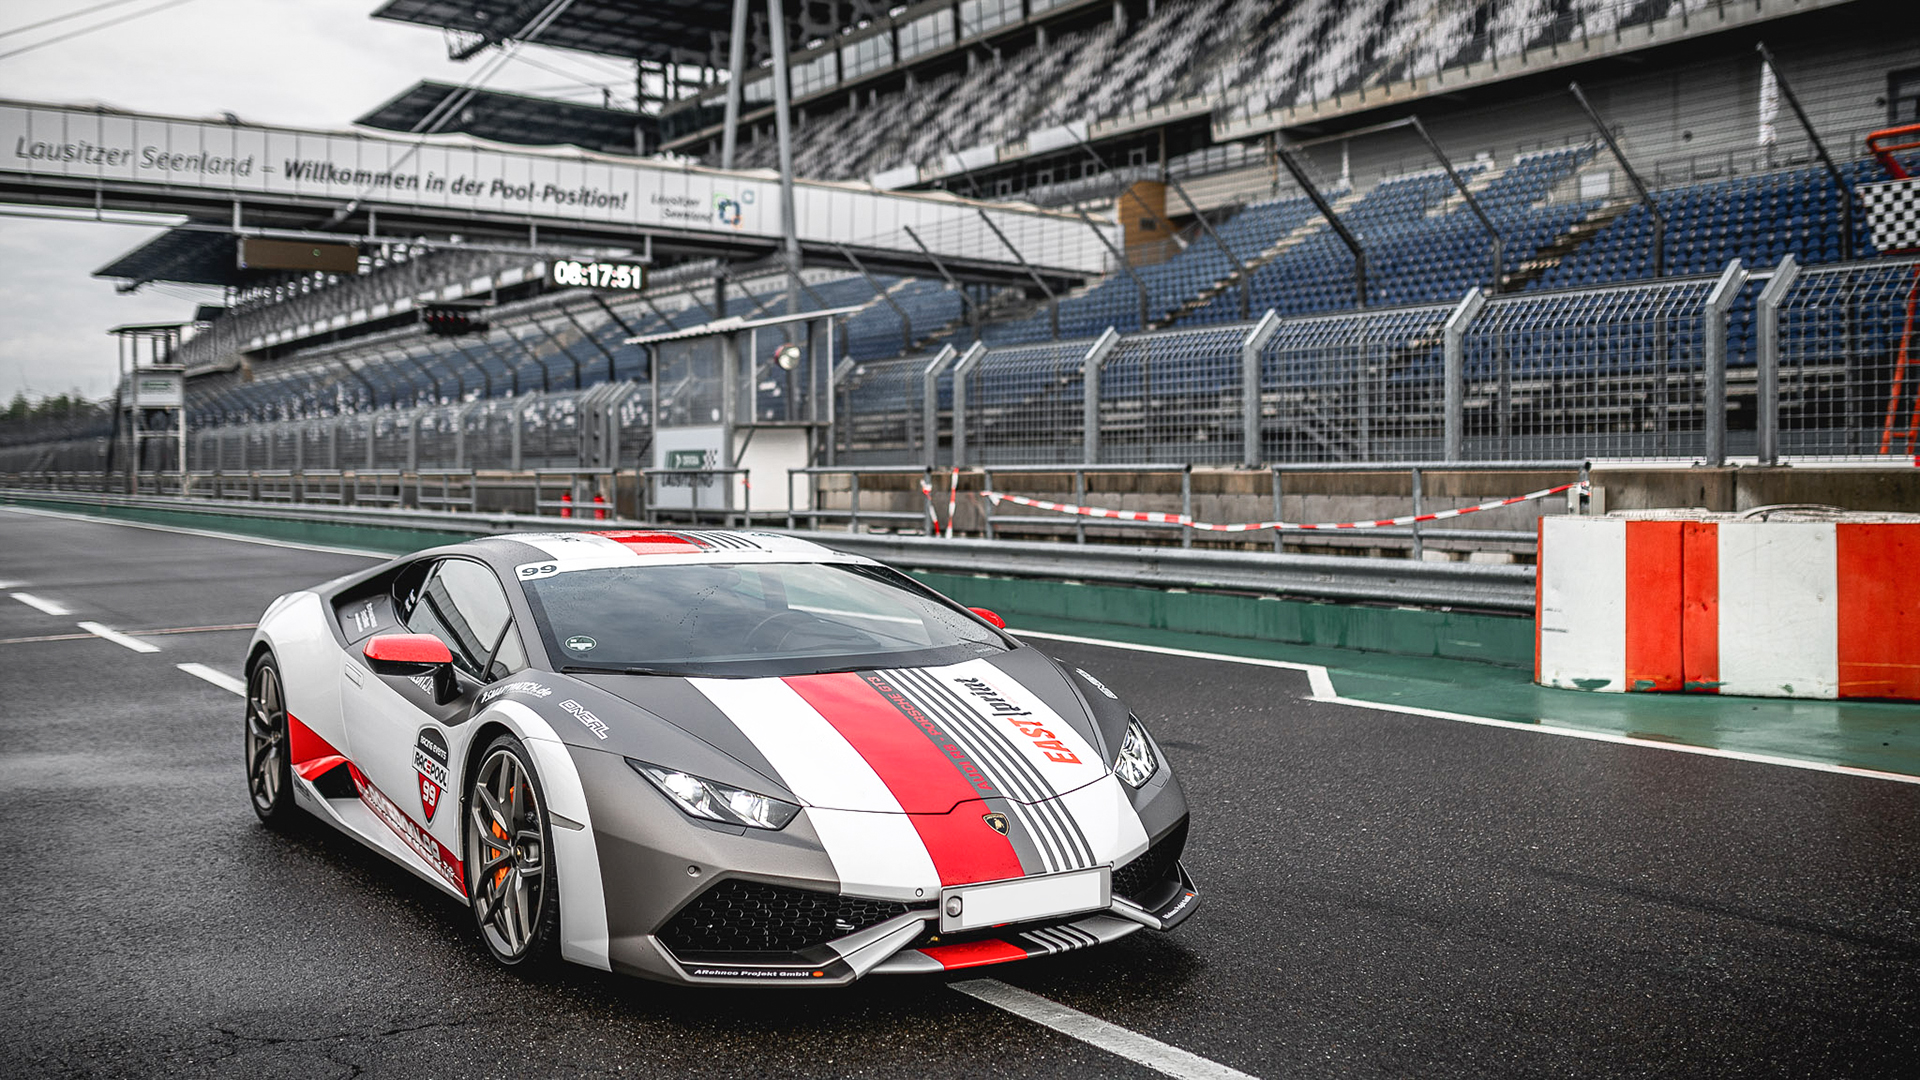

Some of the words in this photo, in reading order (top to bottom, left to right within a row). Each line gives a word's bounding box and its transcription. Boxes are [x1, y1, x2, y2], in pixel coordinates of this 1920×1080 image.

[15, 135, 133, 167] Lausitzer
[139, 145, 254, 178] Seenland
[284, 158, 420, 191] Willkommen
[425, 171, 446, 193] in
[451, 174, 485, 197] der
[489, 178, 629, 211] Pool-Position!
[522, 564, 558, 577] 99
[866, 676, 893, 693] GT3
[887, 693, 943, 737] PORSCHE
[943, 743, 966, 760] R8
[1006, 717, 1083, 765] EAST
[413, 751, 448, 788] RACEPOOL
[957, 761, 993, 791] AUDI
[422, 780, 436, 807] 99
[740, 970, 777, 978] Projekt
